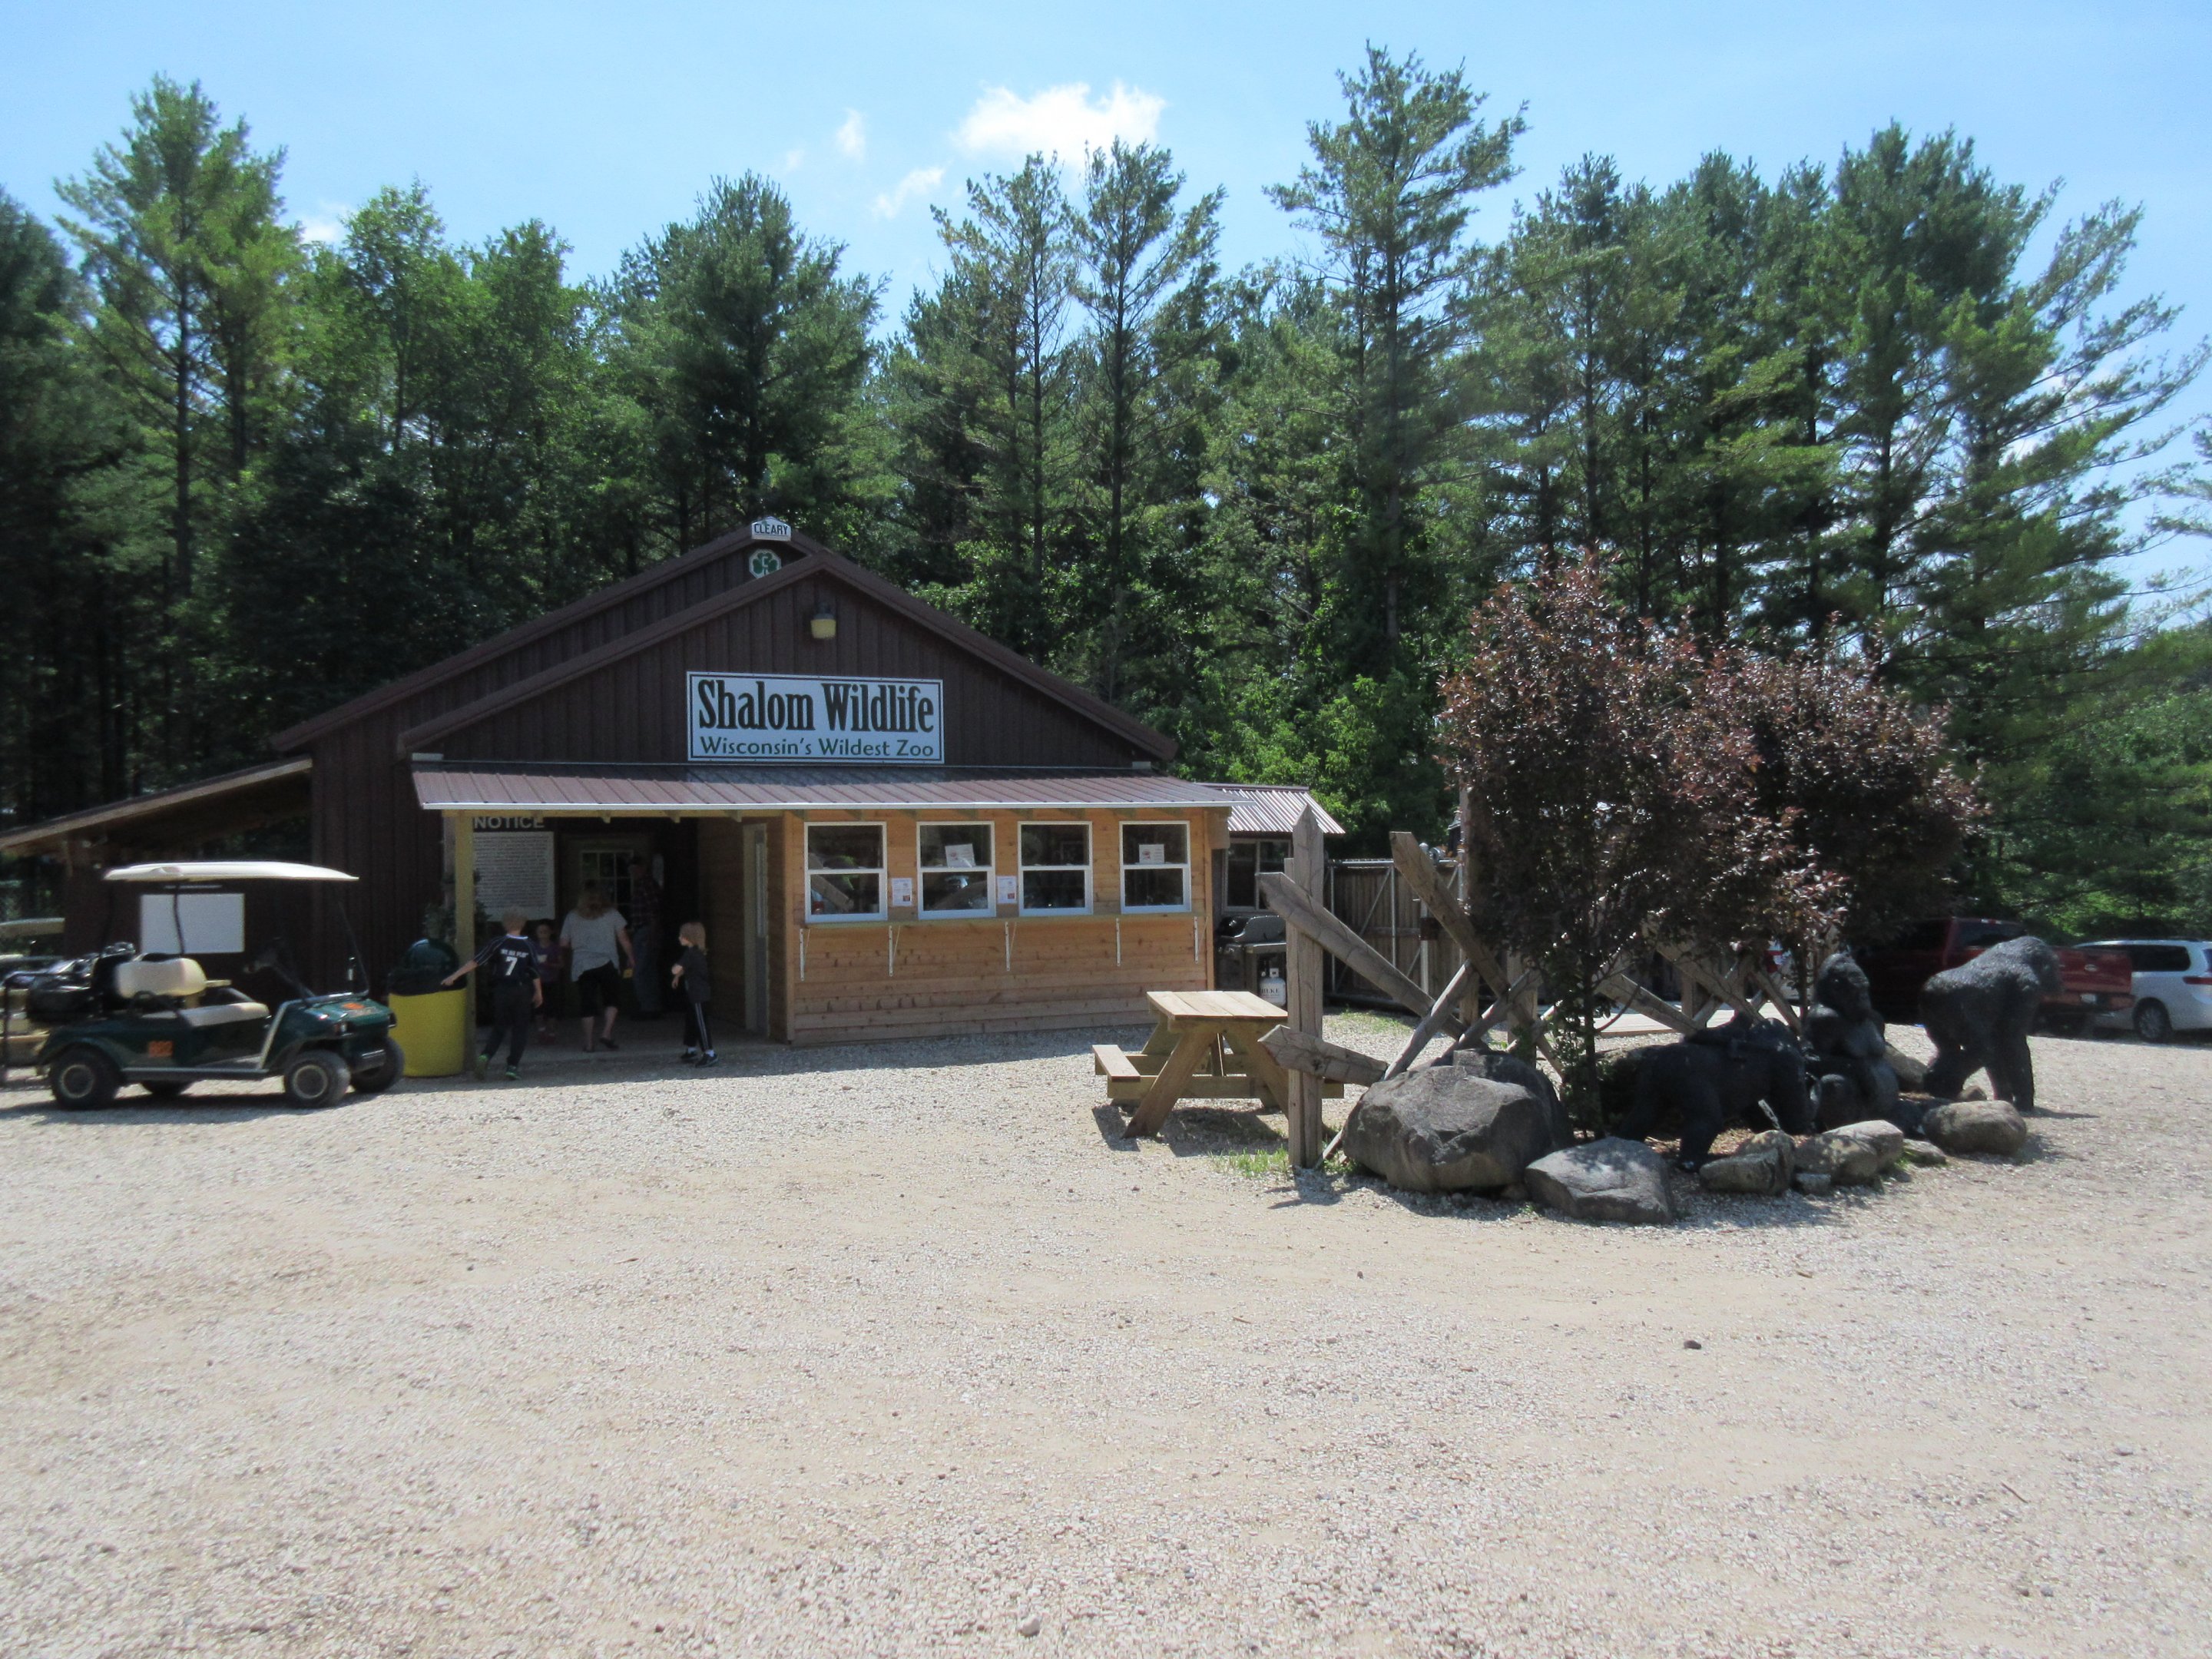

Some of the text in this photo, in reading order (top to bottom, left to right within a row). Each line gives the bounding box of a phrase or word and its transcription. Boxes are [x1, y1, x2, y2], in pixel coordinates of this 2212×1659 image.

[754, 524, 788, 535] CLEARY
[697, 679, 934, 733] Shalom Wildlife
[700, 736, 934, 757] Wisconsin's Wildest Zoo
[474, 816, 545, 829] NOTICE
[505, 955, 518, 975] 7
